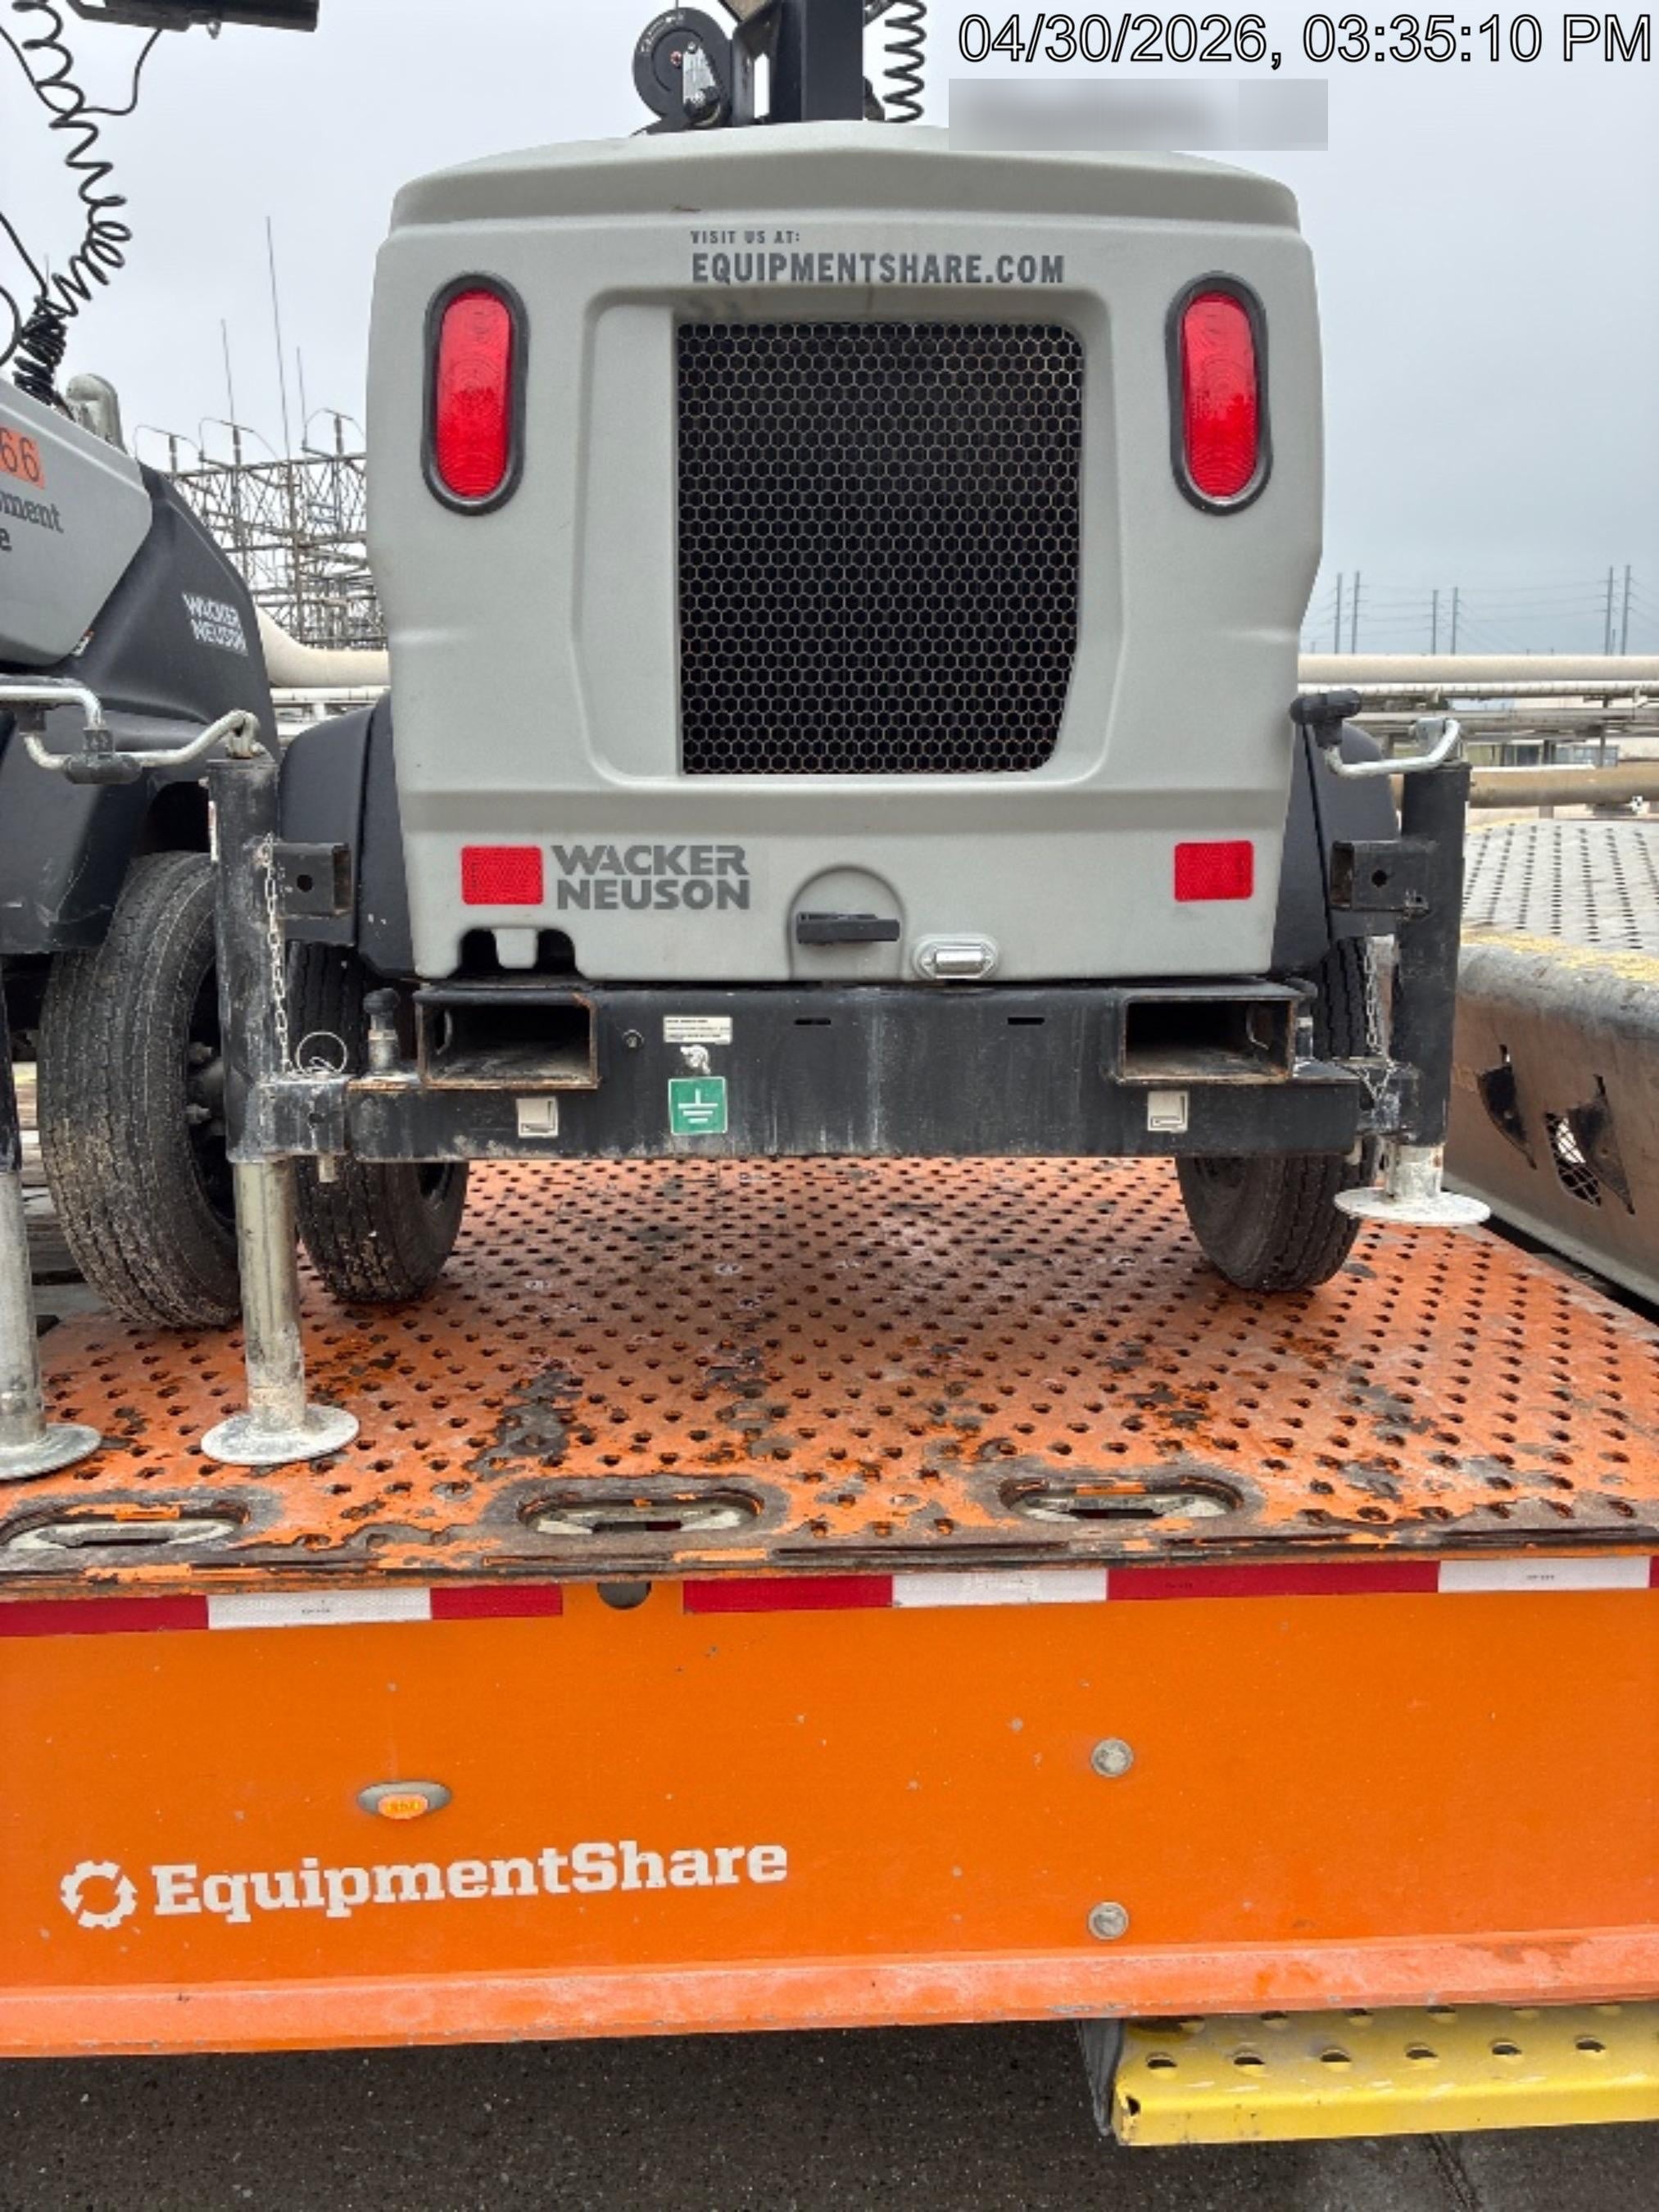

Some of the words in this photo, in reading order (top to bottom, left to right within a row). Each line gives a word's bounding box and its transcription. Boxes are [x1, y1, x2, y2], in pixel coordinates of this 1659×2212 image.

[691, 230, 736, 244] VISIT
[744, 230, 765, 244] US
[773, 230, 800, 244] AT:
[692, 252, 1064, 285] EQUIPMENTSHARE.COM
[0, 492, 65, 533] ment
[551, 845, 750, 876] WACKER
[557, 879, 750, 910] NEUSON
[152, 1840, 787, 1924] EquipmentShare
